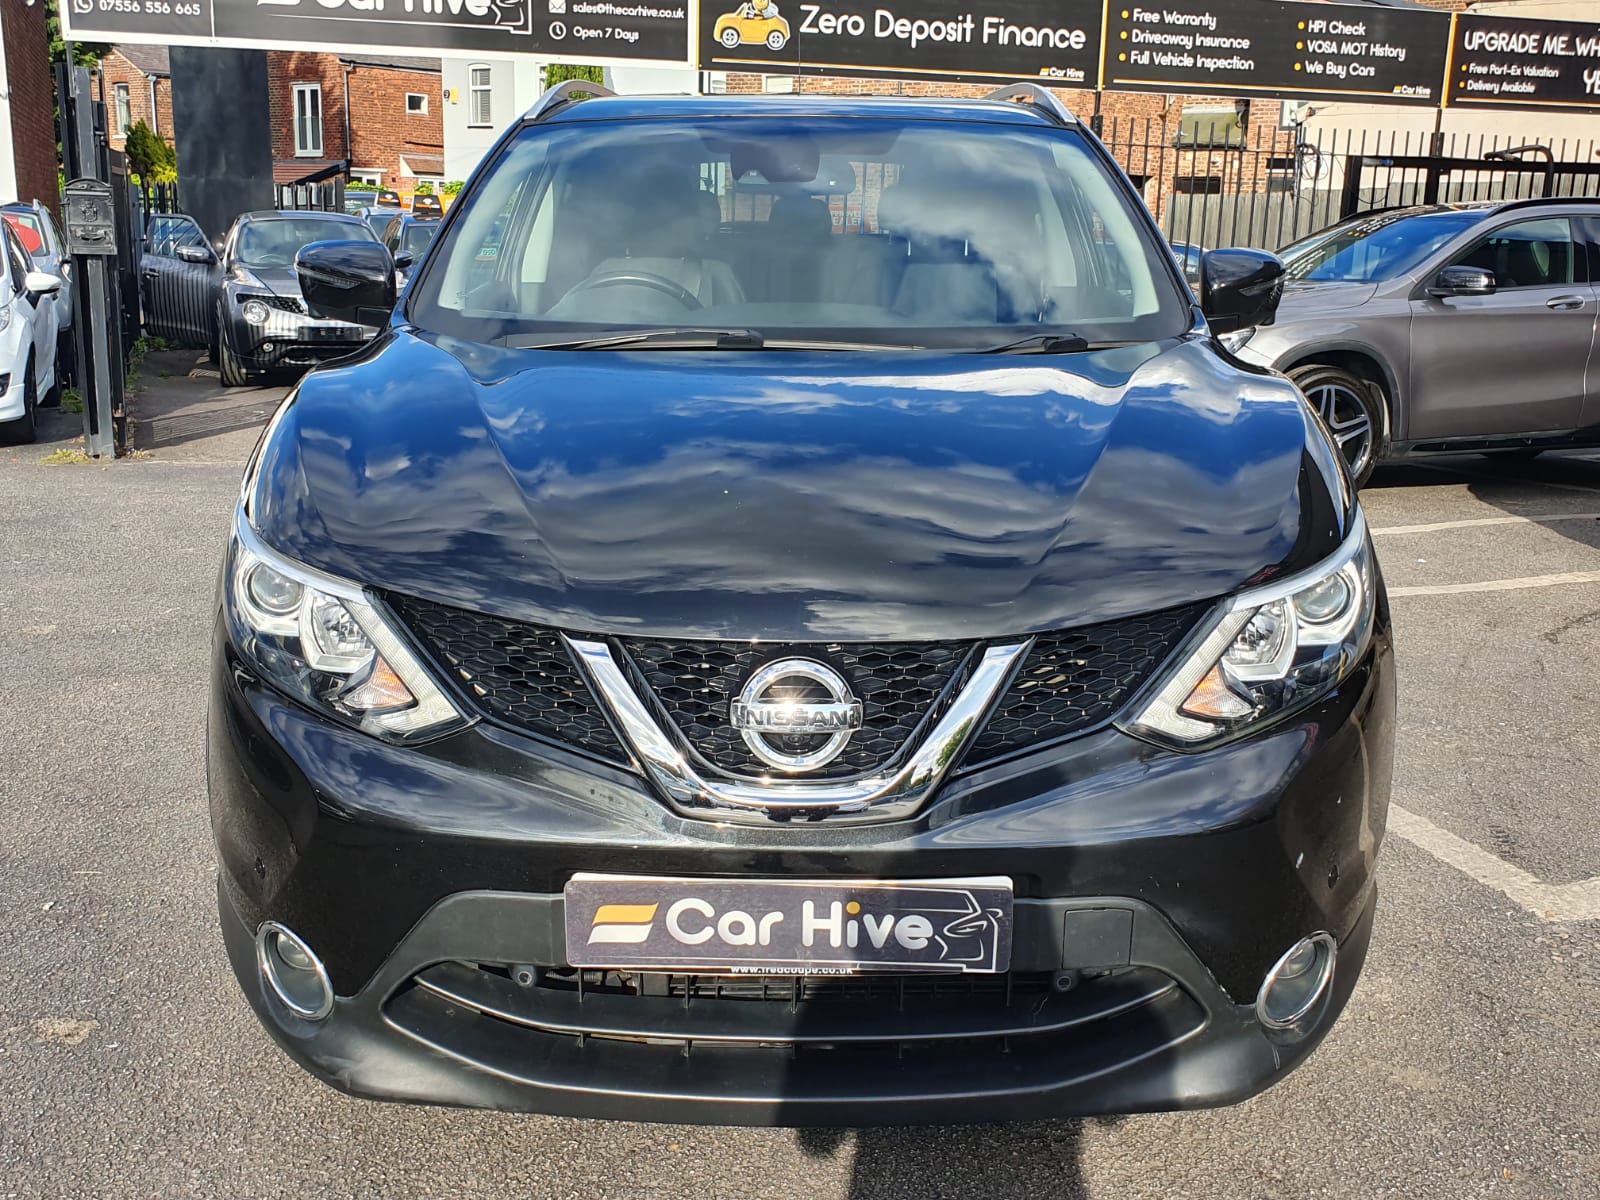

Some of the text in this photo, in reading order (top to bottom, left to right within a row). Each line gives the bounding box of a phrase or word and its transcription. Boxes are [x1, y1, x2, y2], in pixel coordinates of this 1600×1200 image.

[100, 0, 201, 16] 07556 556 665
[572, 2, 685, 18] sales@thecarhive.co.uk
[800, 4, 1086, 50] Zero Deposit Finance
[1133, 8, 1217, 30] Free Warranty
[1308, 20, 1366, 36] HPI Check
[573, 26, 640, 43] Open 7 Days
[1131, 29, 1251, 50] Driveaway Insurance
[1464, 31, 1540, 54] UPGRADE
[1307, 40, 1406, 61] VOSA MOT History
[1130, 51, 1255, 72] Full Vehicle Inspection
[1305, 60, 1376, 79] We Buy Cars
[1468, 63, 1488, 74] Free
[1523, 65, 1559, 78] Valuation
[1050, 66, 1066, 78] Car
[1401, 85, 1415, 95] Car
[1467, 80, 1536, 95] Delivery Available
[746, 709, 848, 727] NISSAN
[665, 897, 934, 950] Car Hive
